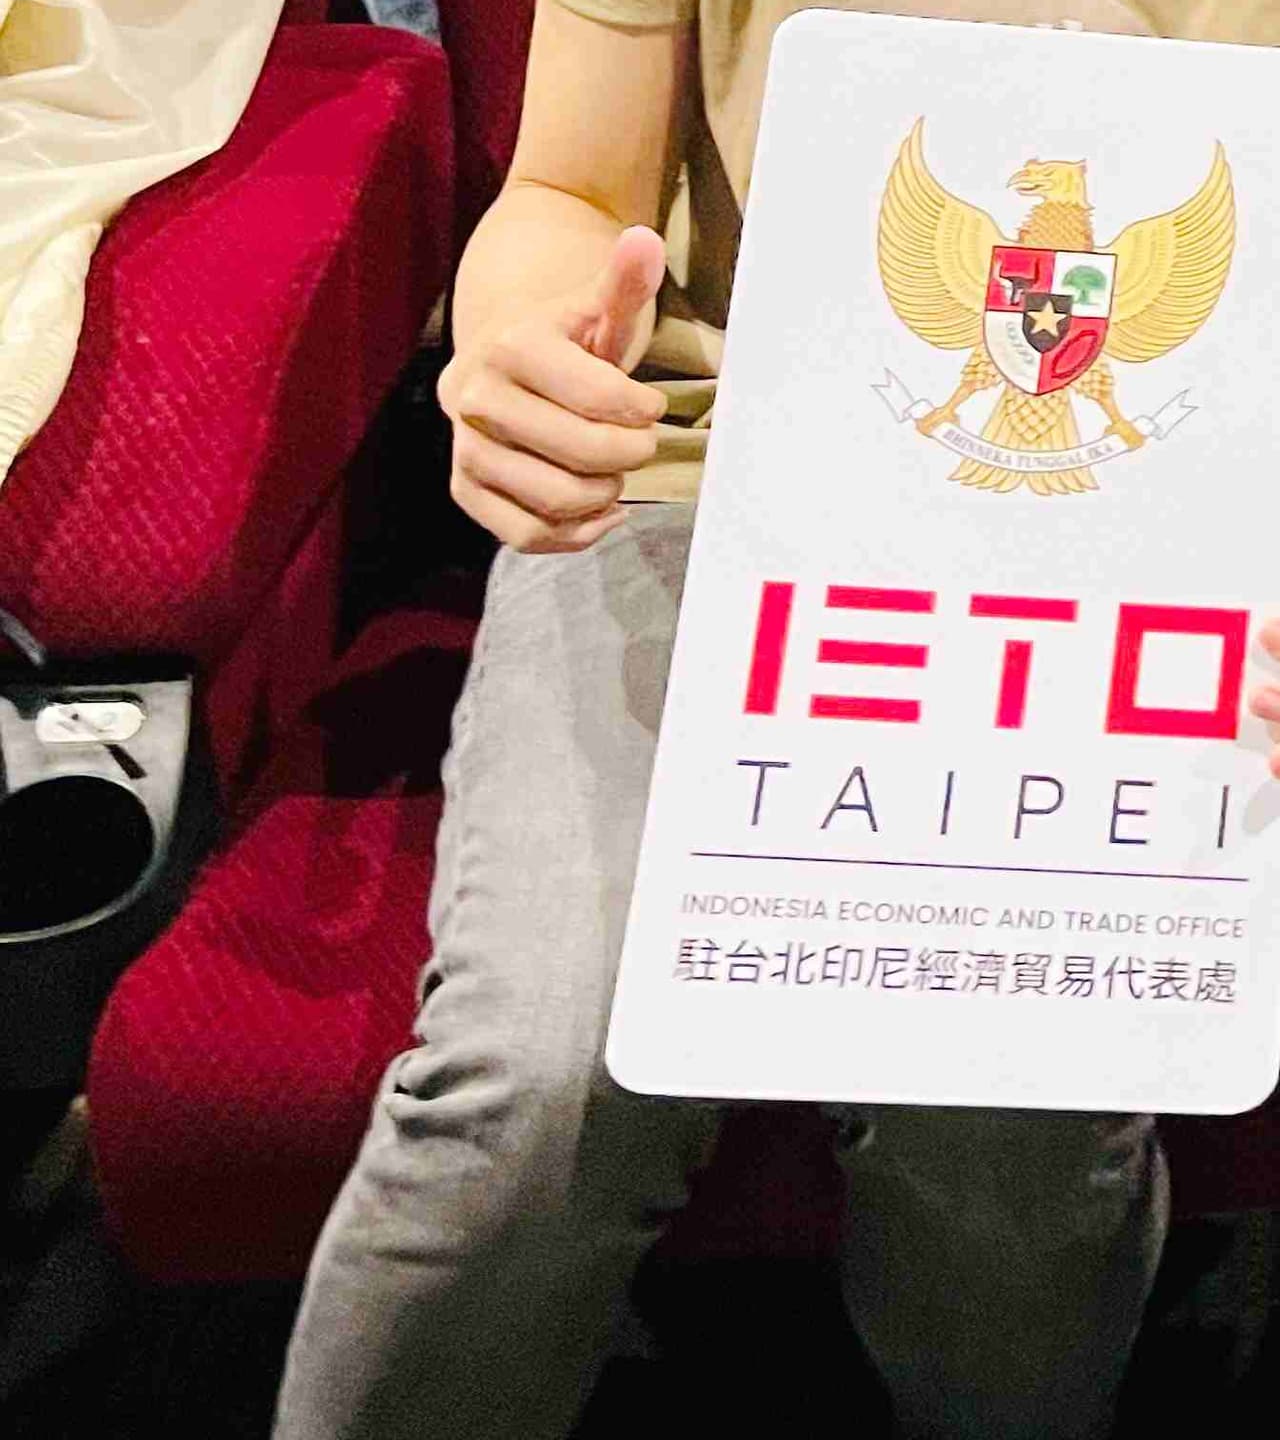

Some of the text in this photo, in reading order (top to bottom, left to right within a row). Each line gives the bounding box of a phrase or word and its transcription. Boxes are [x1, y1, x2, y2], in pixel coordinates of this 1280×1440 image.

[743, 580, 1251, 741] IETO
[736, 759, 1231, 850] TAIPEI
[681, 892, 1248, 940] INDONESIA ECONOMIC AND TRADE OFFICE
[672, 937, 1238, 1003] 駐台北印尼經濟貿易代表處
